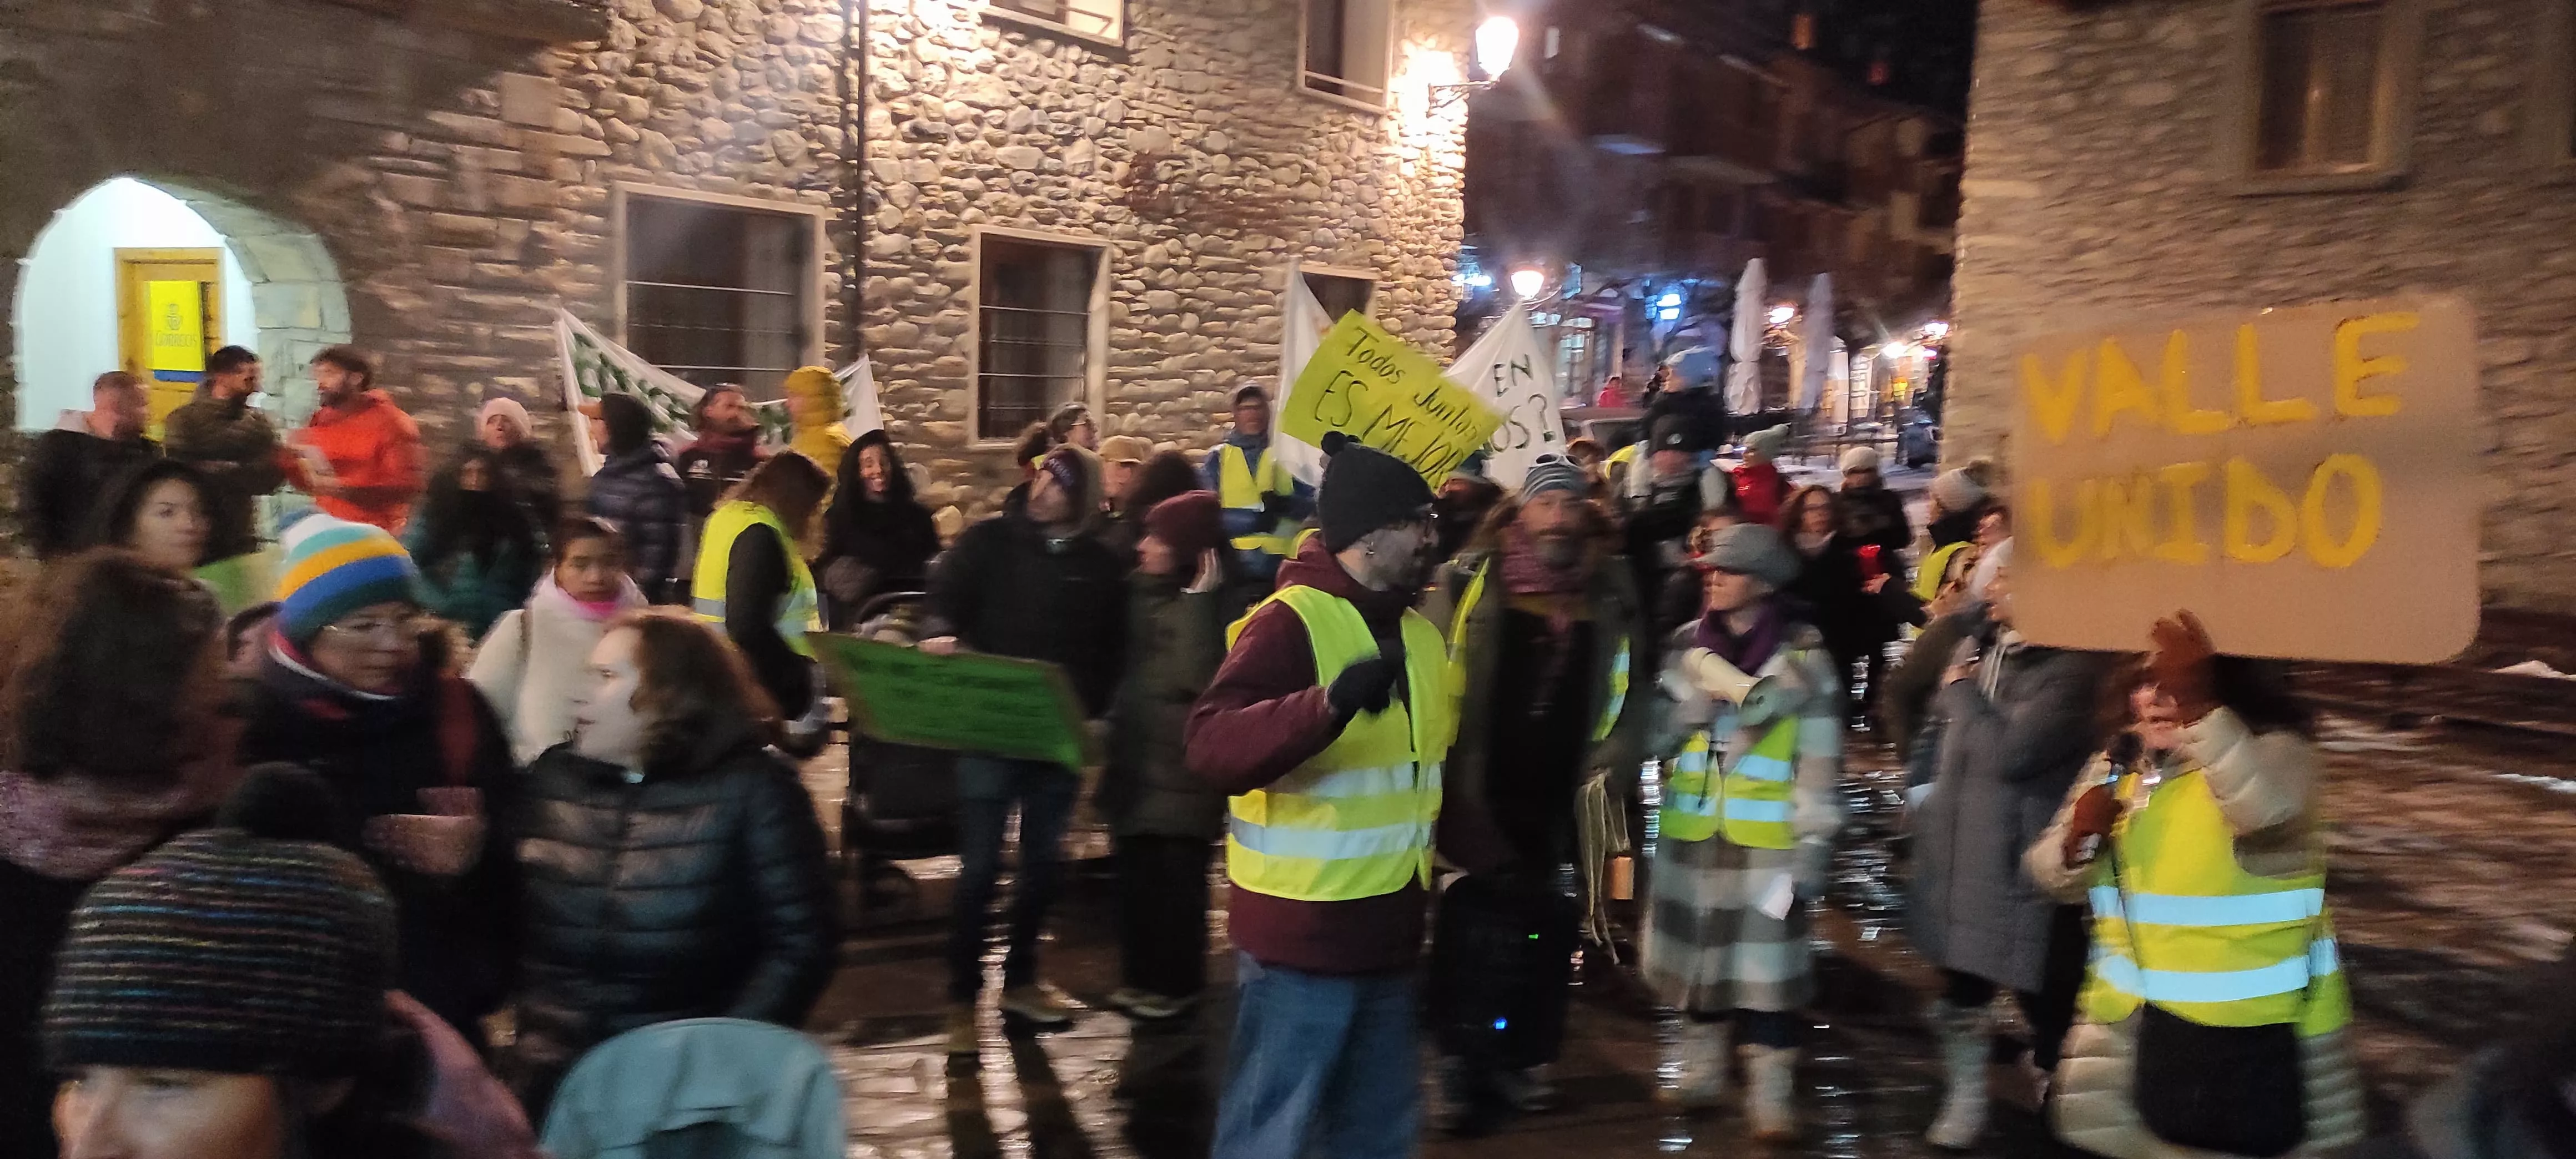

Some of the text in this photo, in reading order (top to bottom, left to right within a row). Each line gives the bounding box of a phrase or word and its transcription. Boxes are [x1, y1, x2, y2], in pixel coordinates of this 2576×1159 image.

[1346, 326, 1406, 384] Todos
[1493, 354, 1533, 397] EN
[2017, 311, 2420, 442] VALLE
[1315, 370, 1369, 427] ES
[1483, 393, 1556, 453] OS?
[2027, 452, 2383, 568] UNIDO
